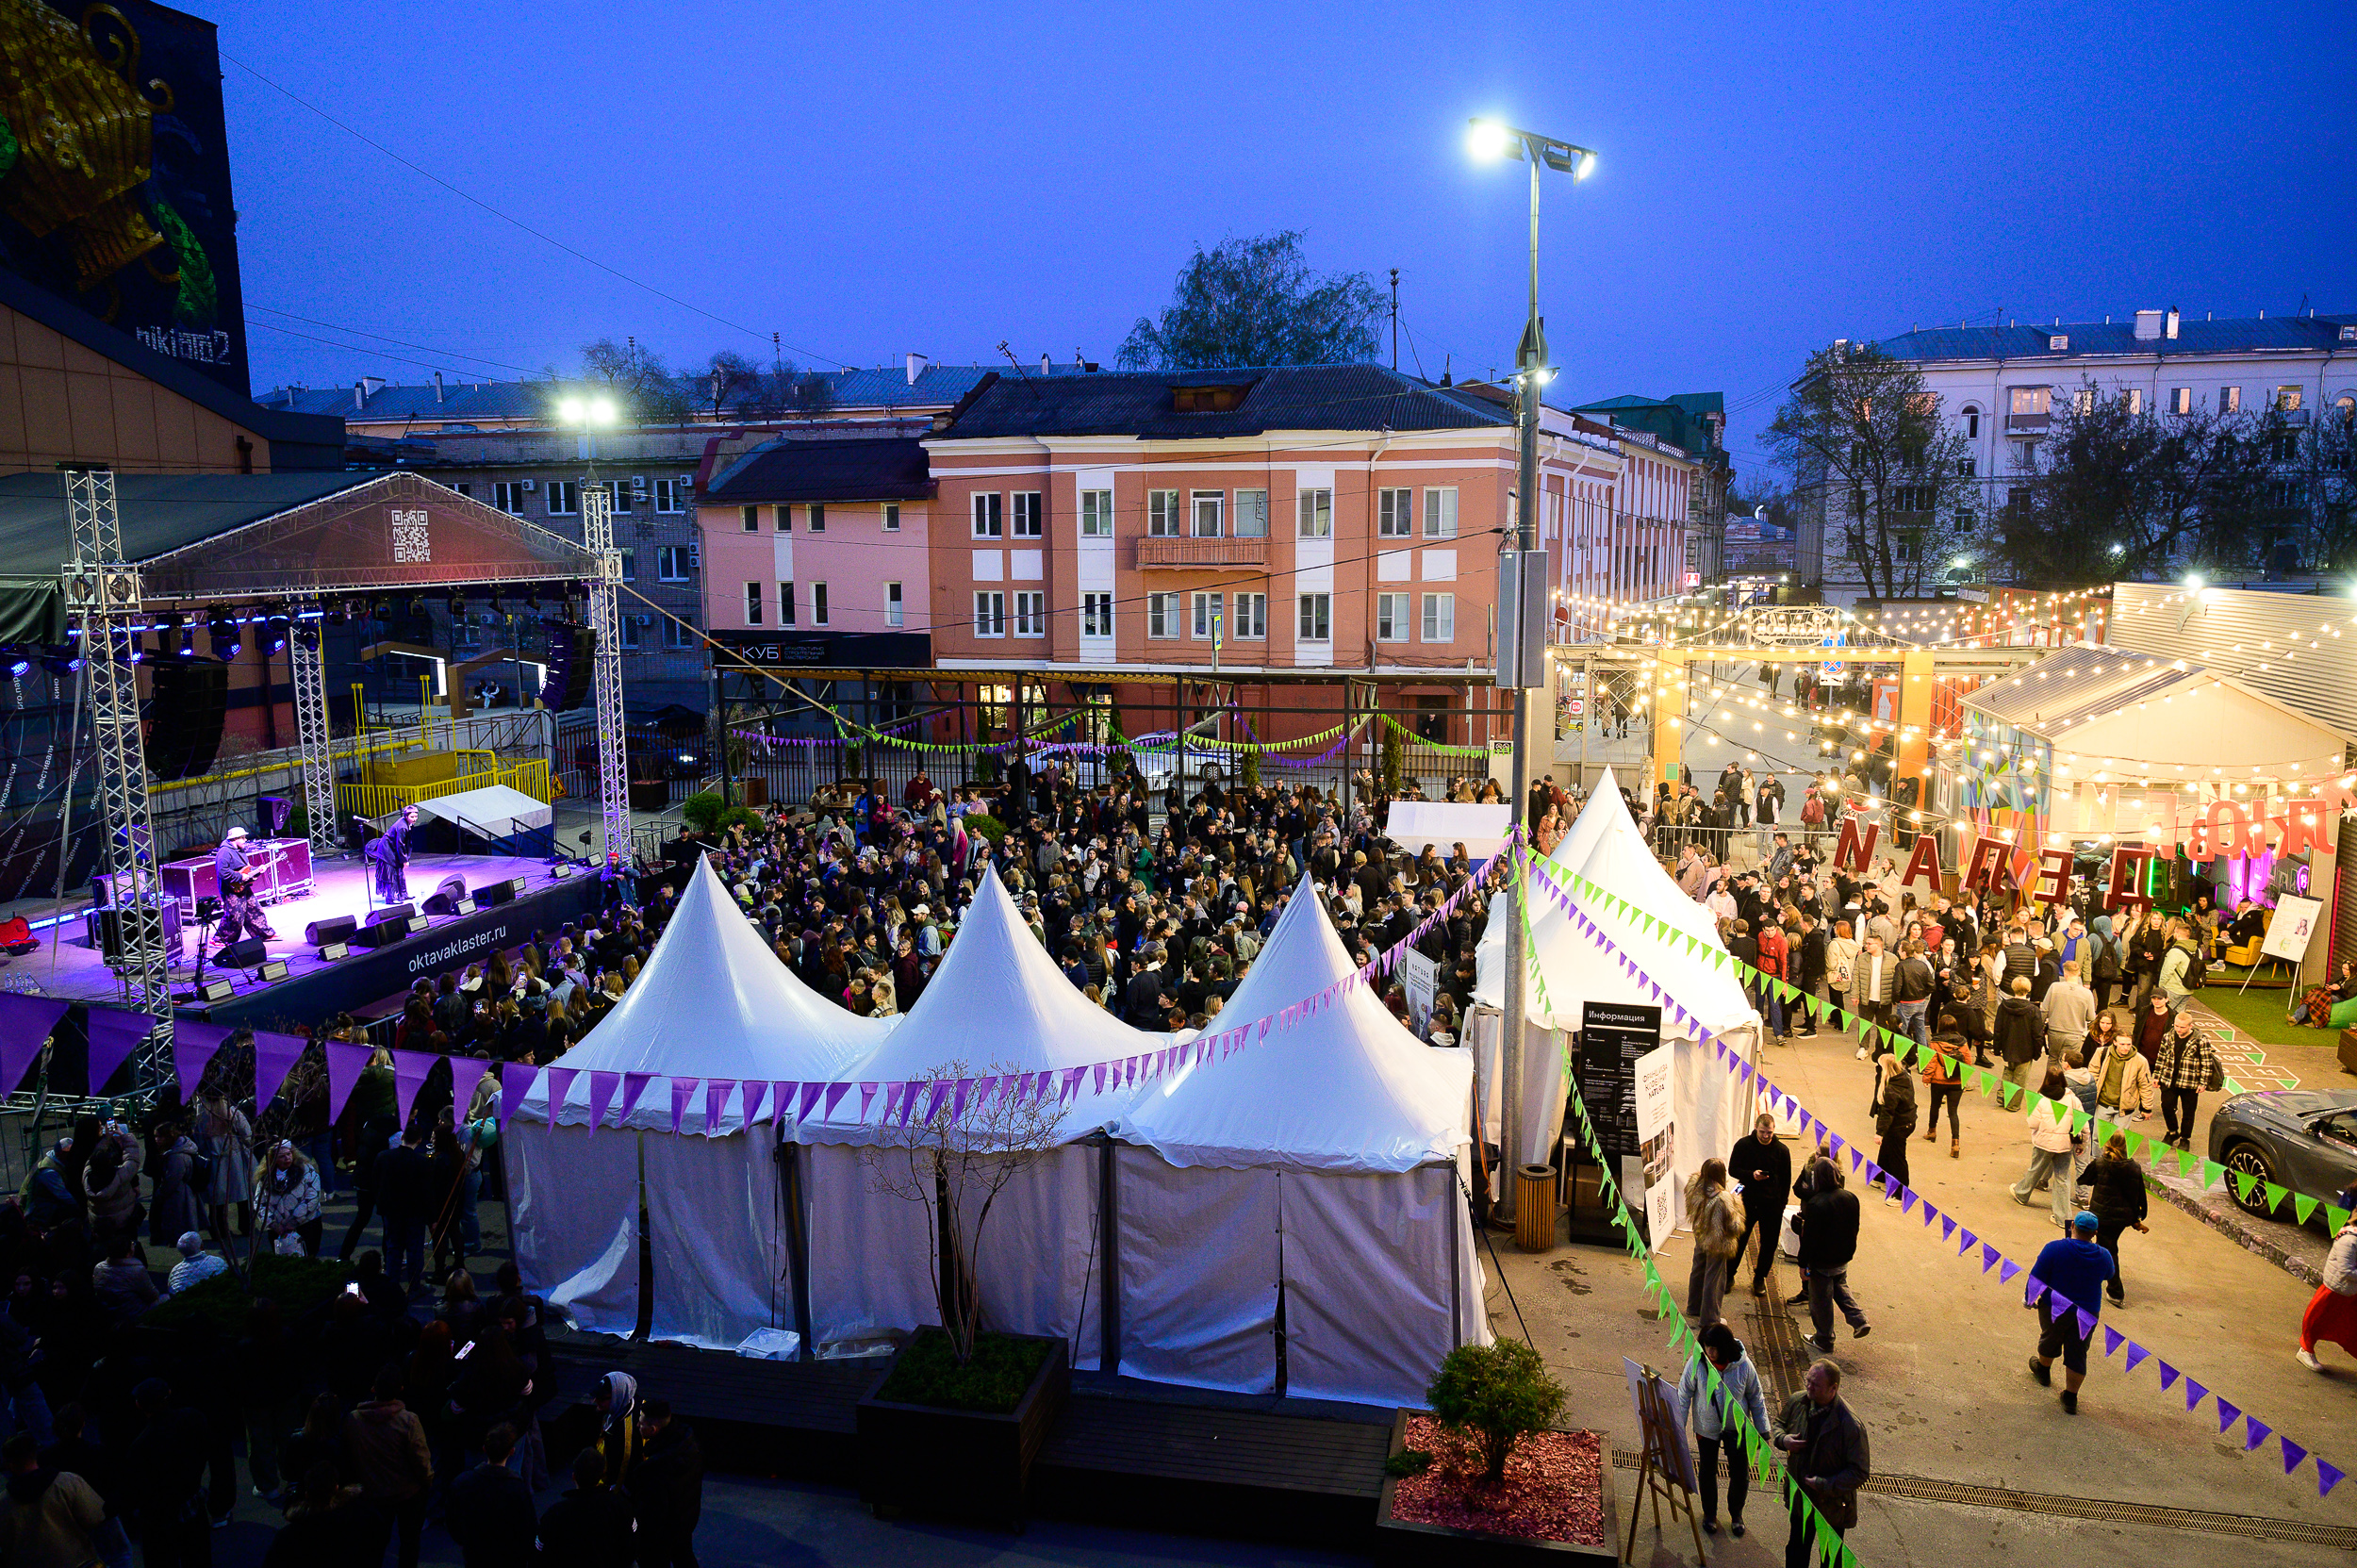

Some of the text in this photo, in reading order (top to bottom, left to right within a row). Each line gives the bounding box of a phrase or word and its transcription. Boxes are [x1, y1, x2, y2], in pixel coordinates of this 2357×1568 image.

[37, 745, 55, 790] фестивали
[2, 829, 25, 867] выставки
[14, 849, 46, 901] омикс-клубы
[408, 925, 506, 972] oktavaklaster.ru
[1589, 1010, 1645, 1022] Информация
